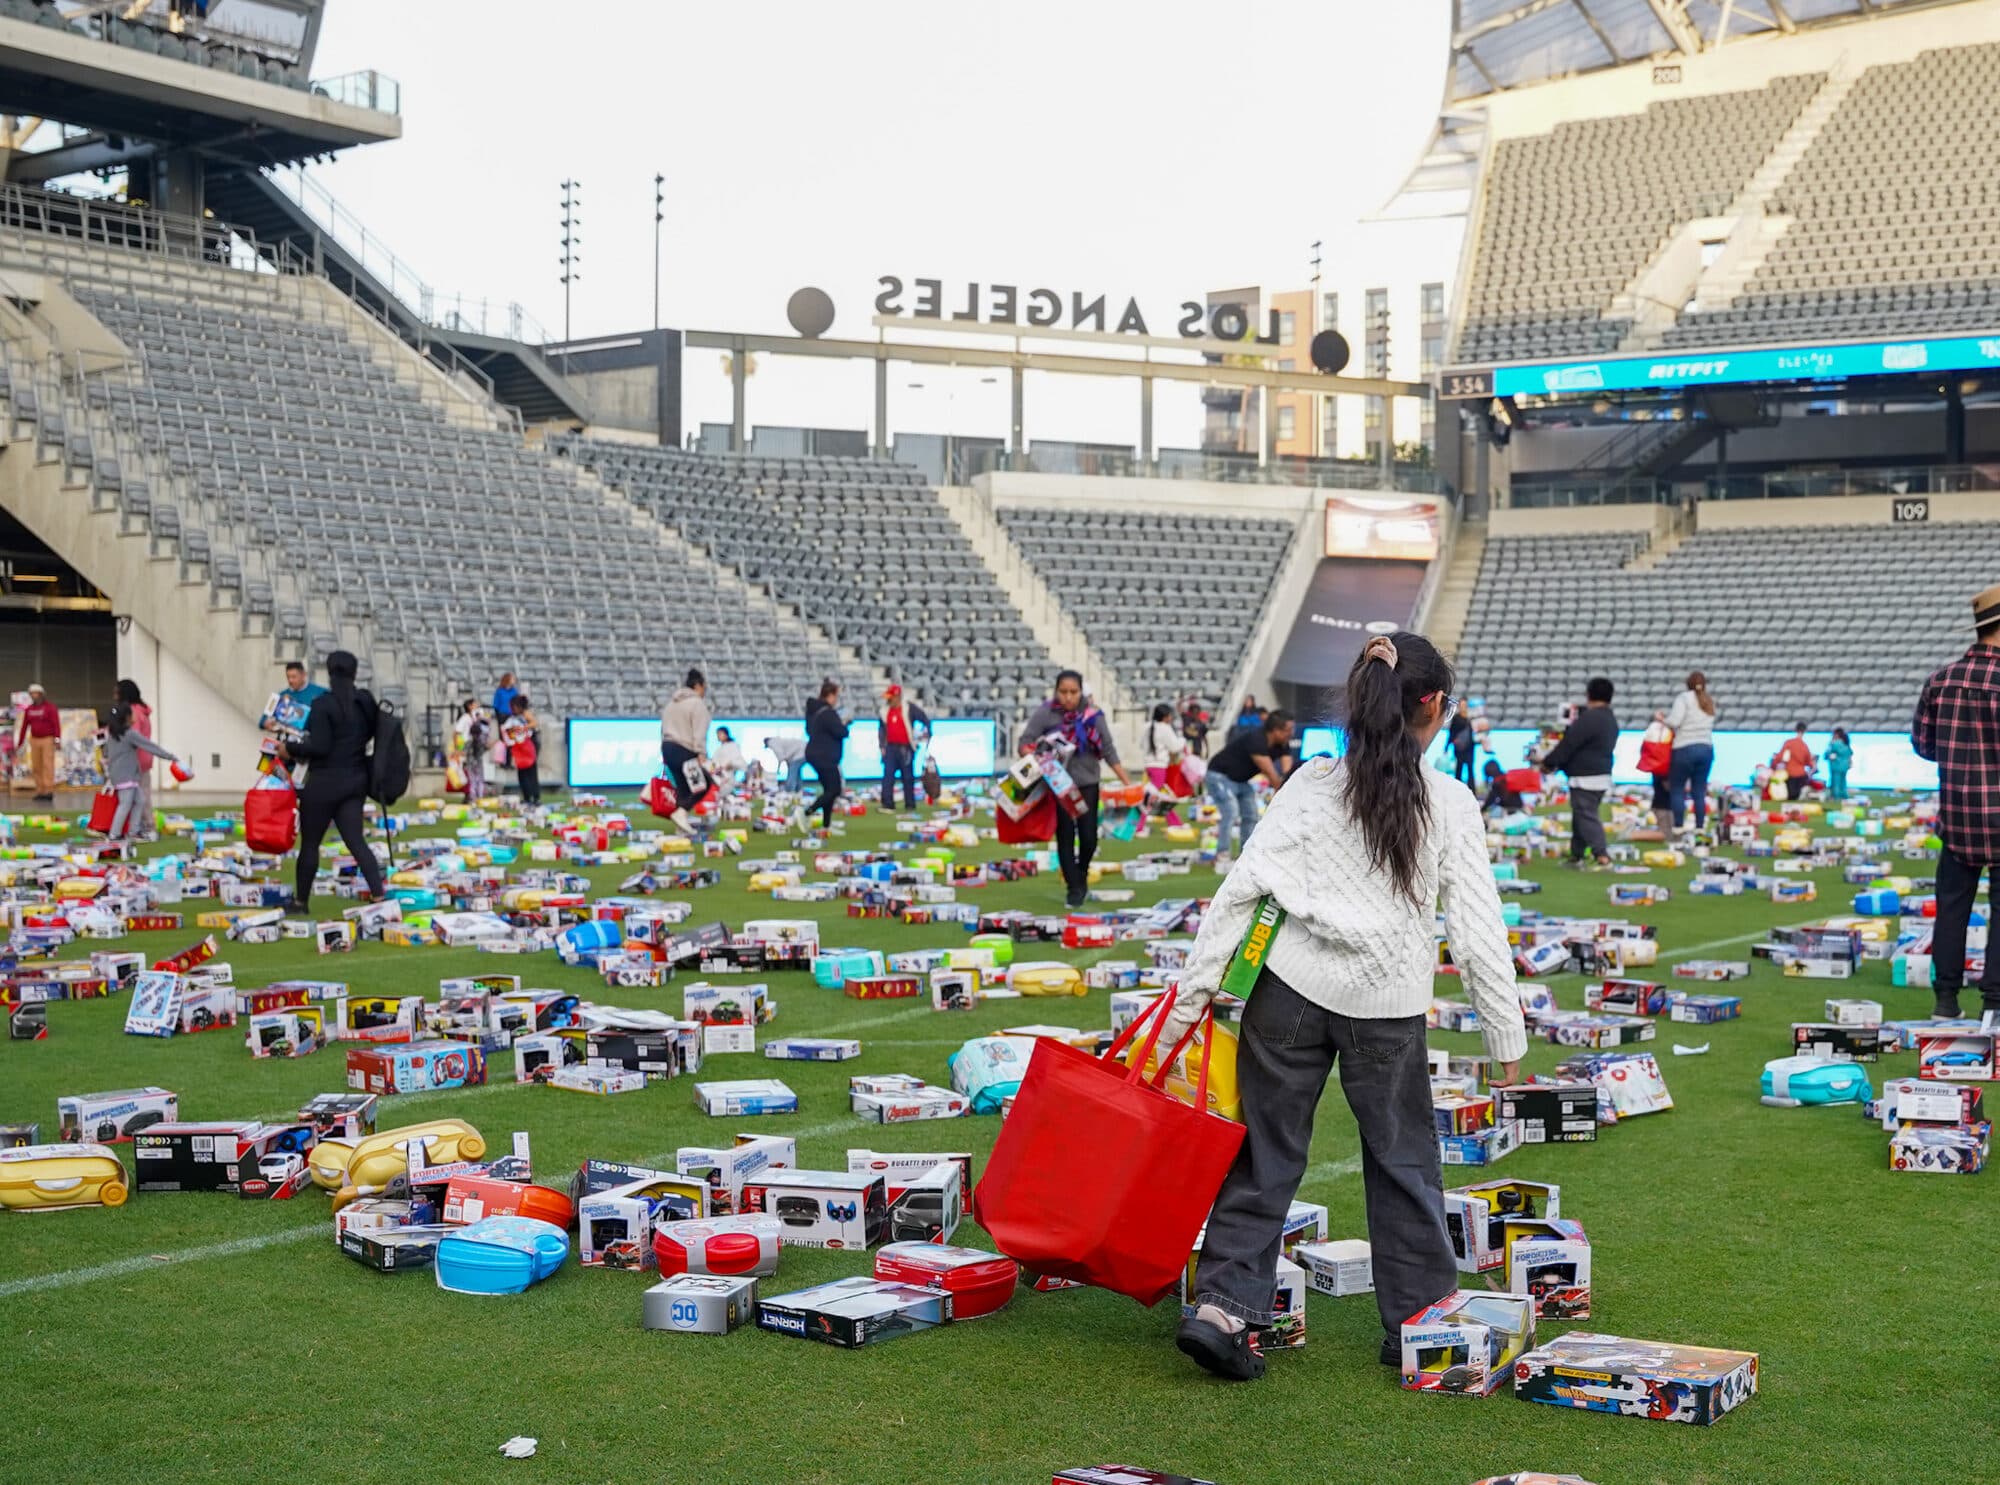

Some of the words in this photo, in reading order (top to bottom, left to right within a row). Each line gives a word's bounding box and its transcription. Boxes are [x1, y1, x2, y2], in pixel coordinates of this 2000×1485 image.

[1648, 361, 1729, 379] RITFIT
[1450, 376, 1485, 394] 3:54
[1896, 503, 1927, 520] 109
[921, 1159, 938, 1167] DIVO
[244, 1182, 266, 1191] BUGATTI
[796, 1239, 824, 1248] BUGATTI
[671, 1303, 698, 1321] DC
[762, 1312, 805, 1332] HORNET
[1404, 1331, 1461, 1344] LAMBORGHINI
